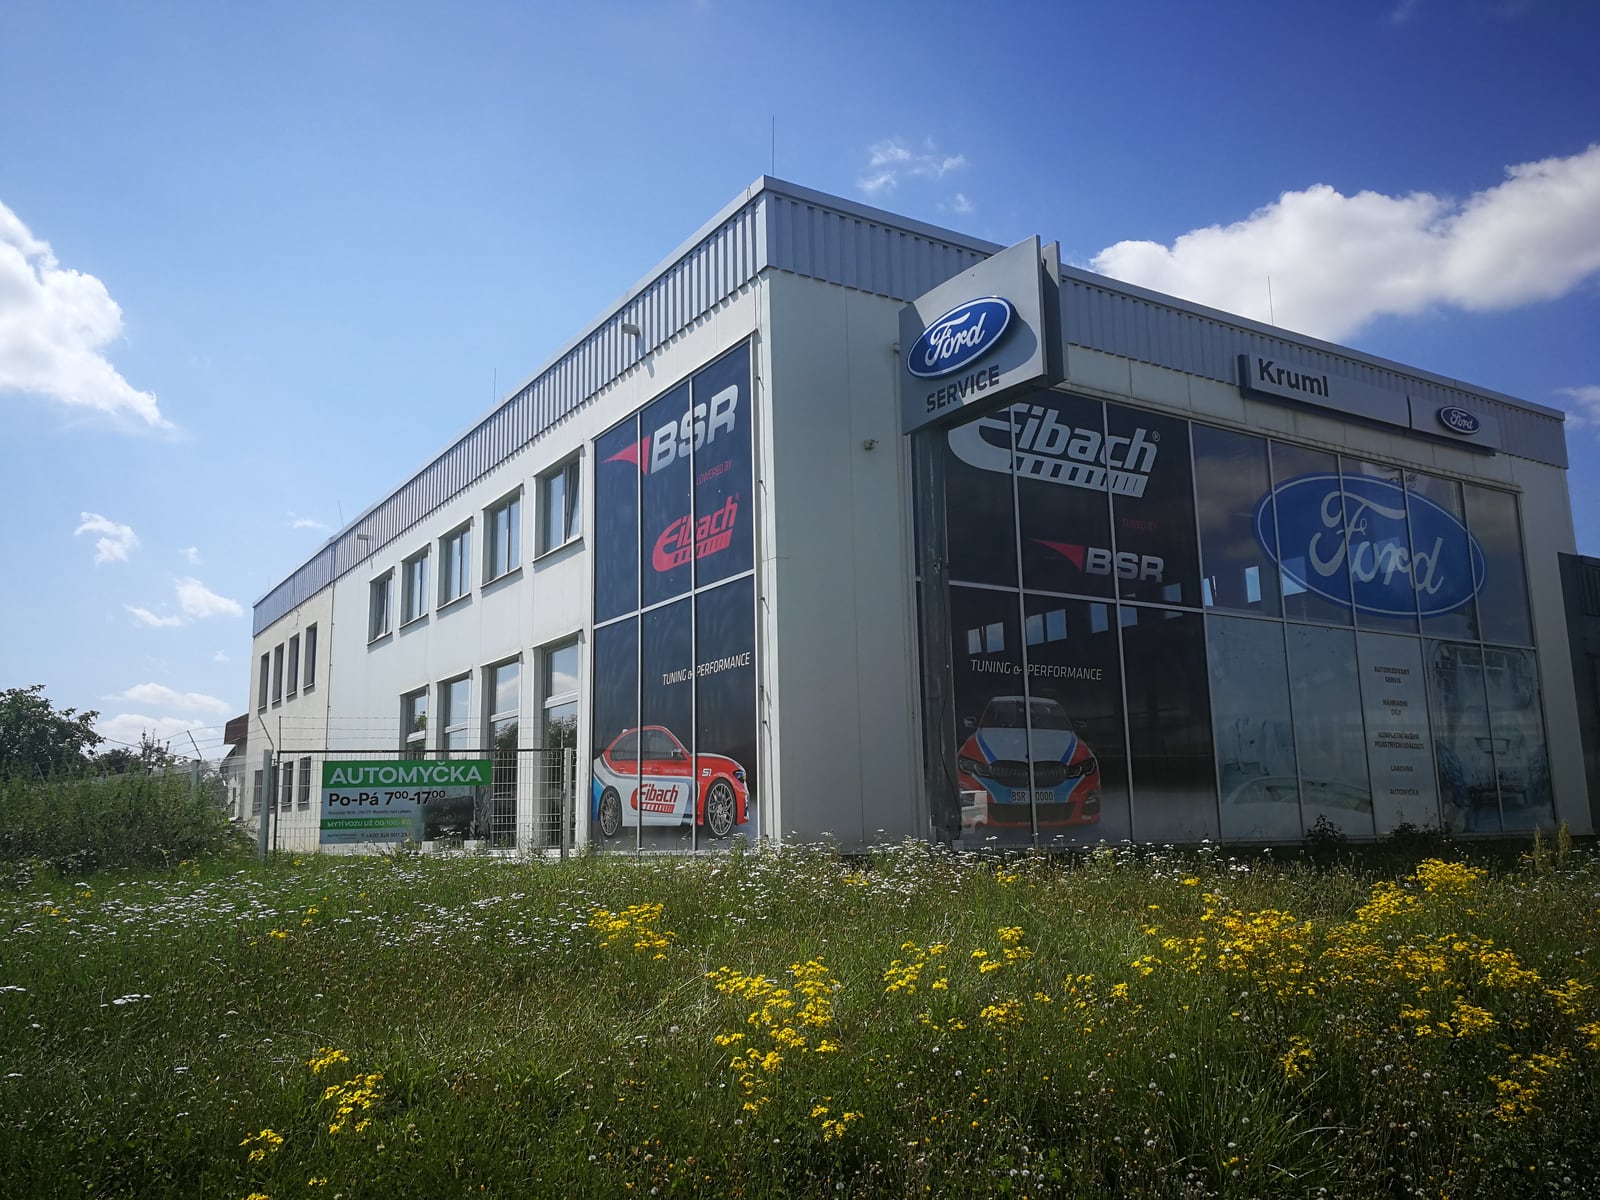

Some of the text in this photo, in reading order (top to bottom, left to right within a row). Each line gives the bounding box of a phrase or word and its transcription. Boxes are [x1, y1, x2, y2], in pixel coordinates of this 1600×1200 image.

[925, 312, 987, 366] Ford
[927, 365, 1000, 413] SERVICE
[1258, 358, 1328, 397] Kruml
[651, 385, 738, 474] BSR
[1450, 410, 1473, 429] Ford
[1309, 491, 1444, 594] Ford
[1085, 547, 1165, 583] BSR
[662, 668, 687, 685] TUNING
[696, 652, 750, 677] PERFORMANCE
[970, 659, 1011, 674] TUNING
[1026, 663, 1102, 680] PERFORMANCE
[329, 761, 482, 785] AUTOMYČKA
[329, 792, 379, 806] Po-Pá
